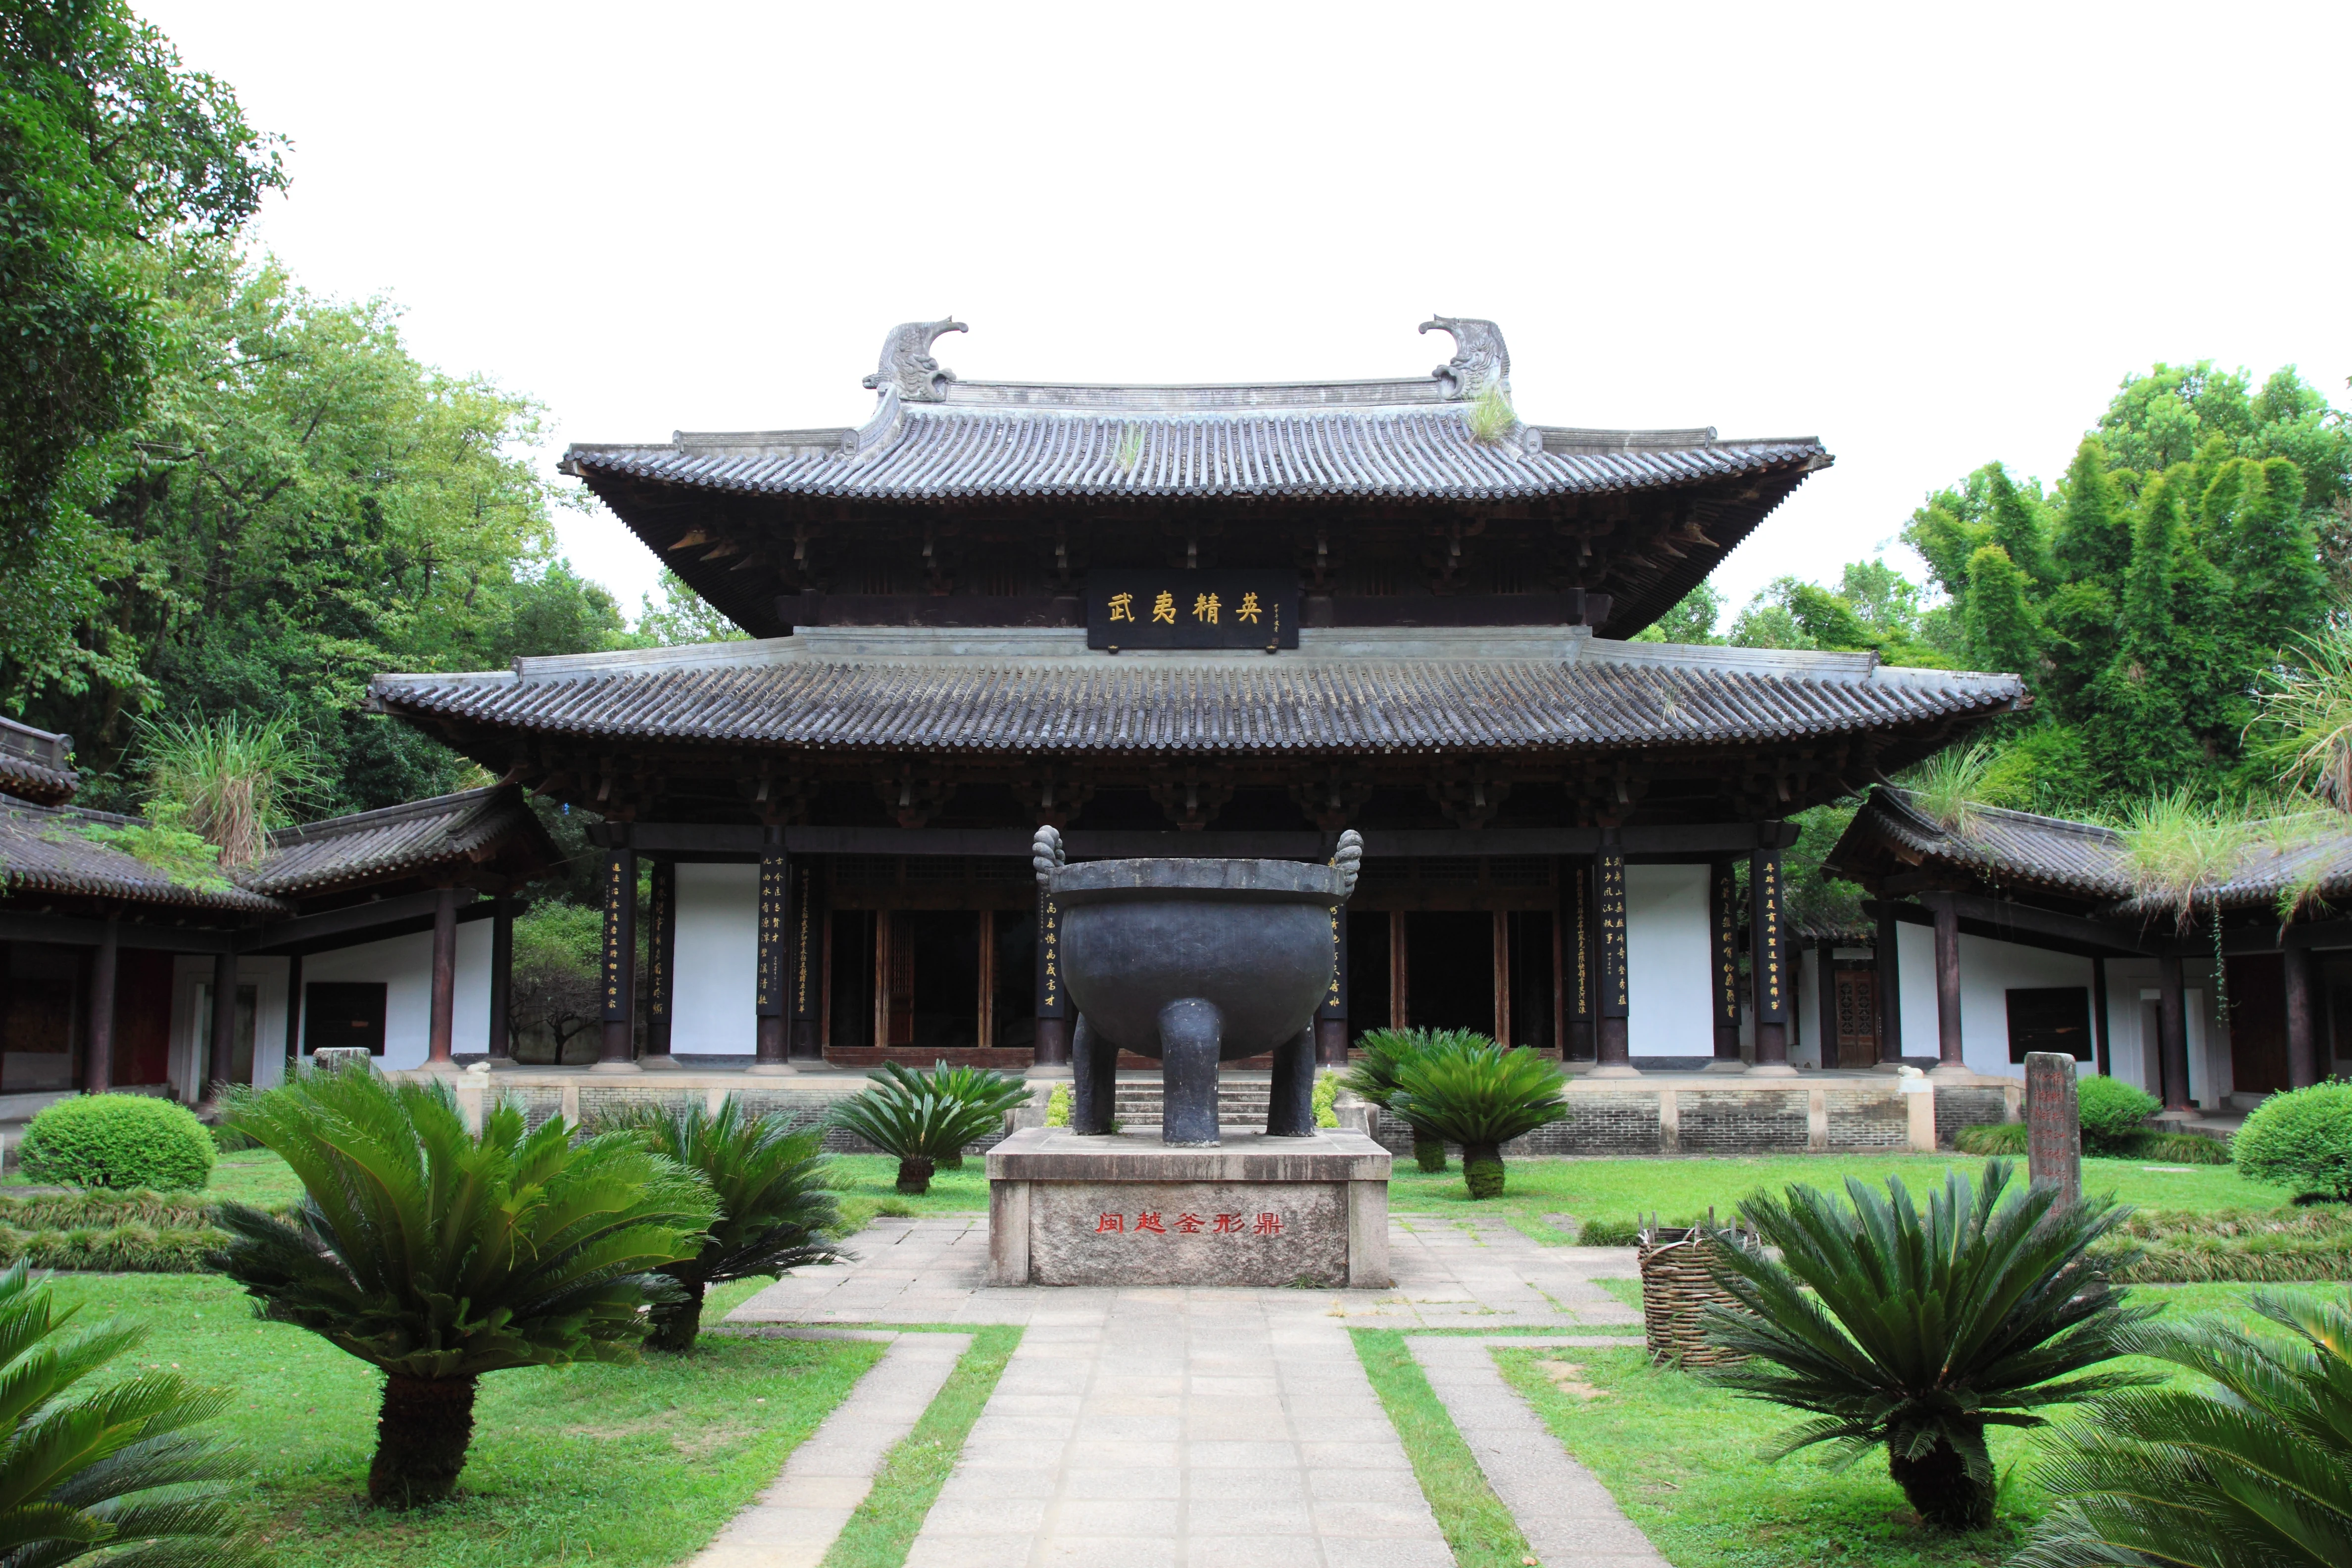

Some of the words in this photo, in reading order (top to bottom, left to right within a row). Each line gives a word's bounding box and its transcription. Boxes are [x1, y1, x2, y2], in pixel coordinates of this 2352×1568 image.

[1108, 590, 1262, 624] 武夷精英
[1095, 1211, 1284, 1235] 闽越釜形鼎
